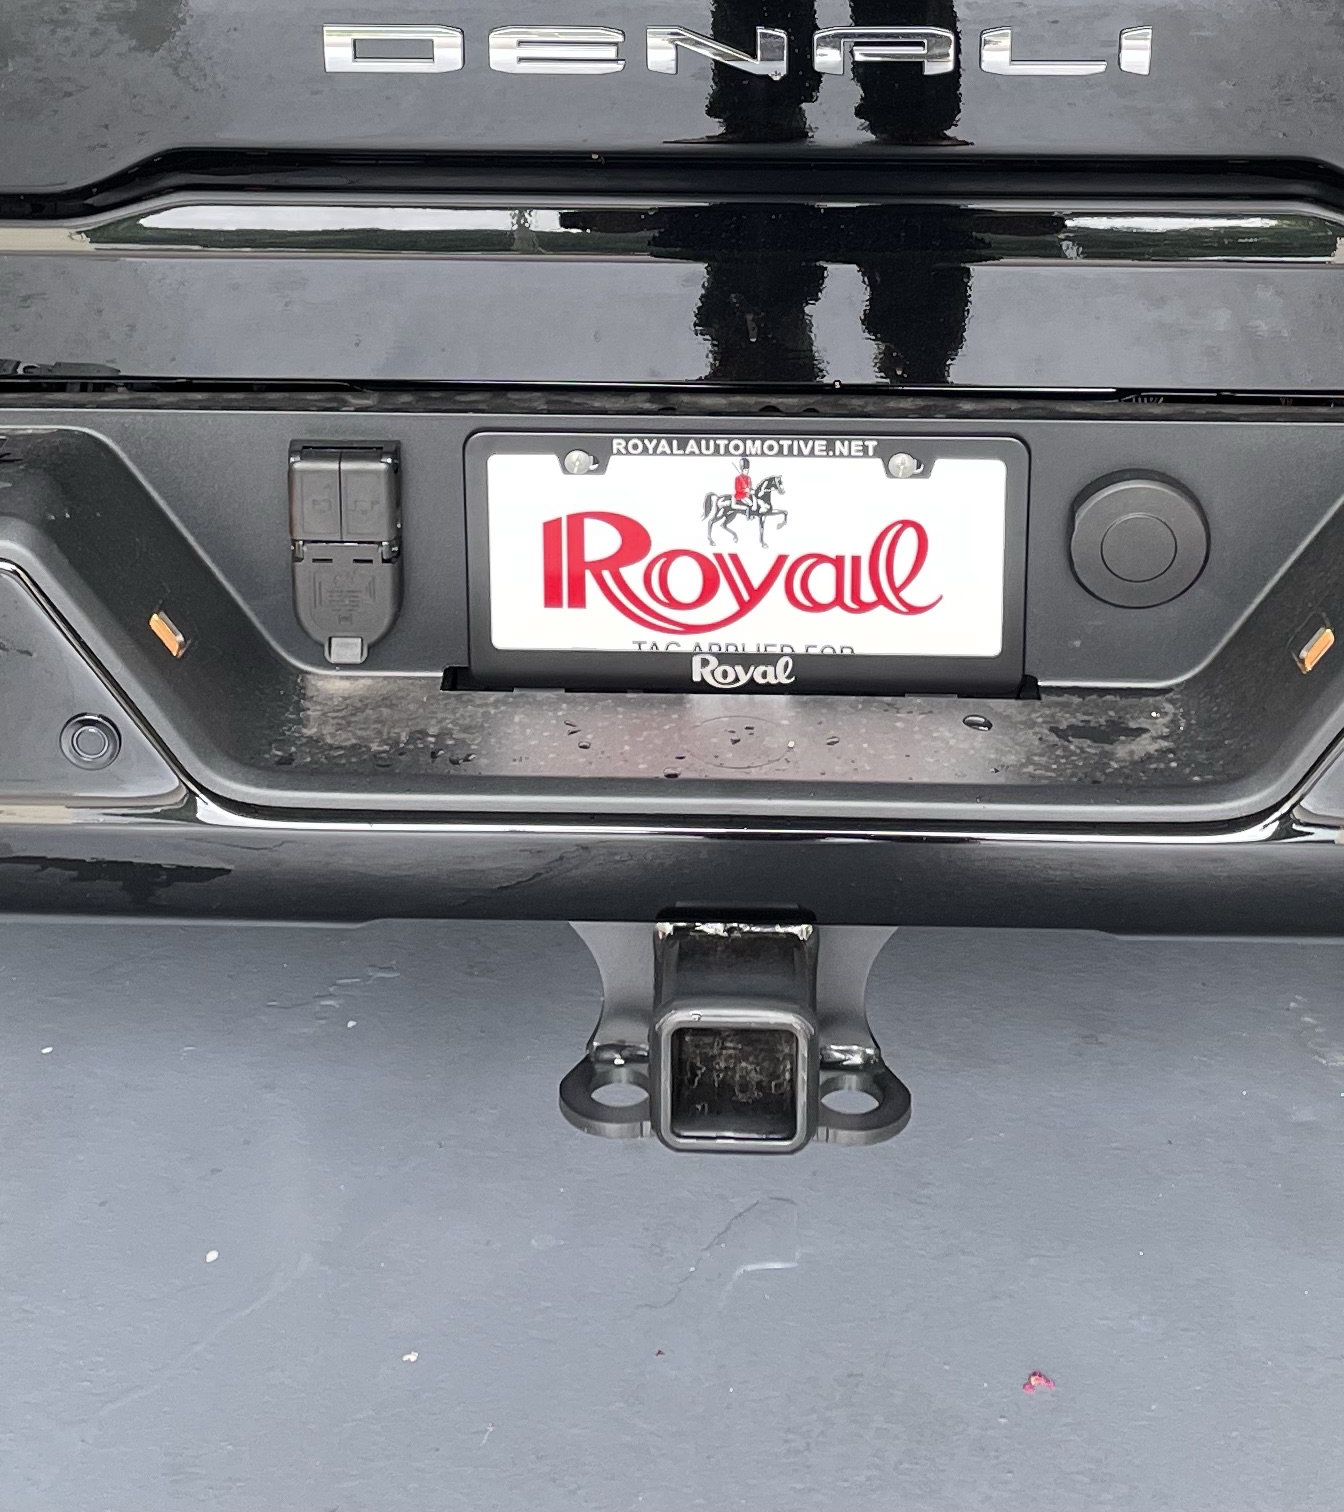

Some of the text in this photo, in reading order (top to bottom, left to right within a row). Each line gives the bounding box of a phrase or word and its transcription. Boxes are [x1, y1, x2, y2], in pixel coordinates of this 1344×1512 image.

[322, 23, 1153, 78] DENALI
[612, 438, 879, 458] ROYALAUTOMOTIVE.NET
[542, 511, 944, 635] Royal
[691, 653, 796, 689] Royal
